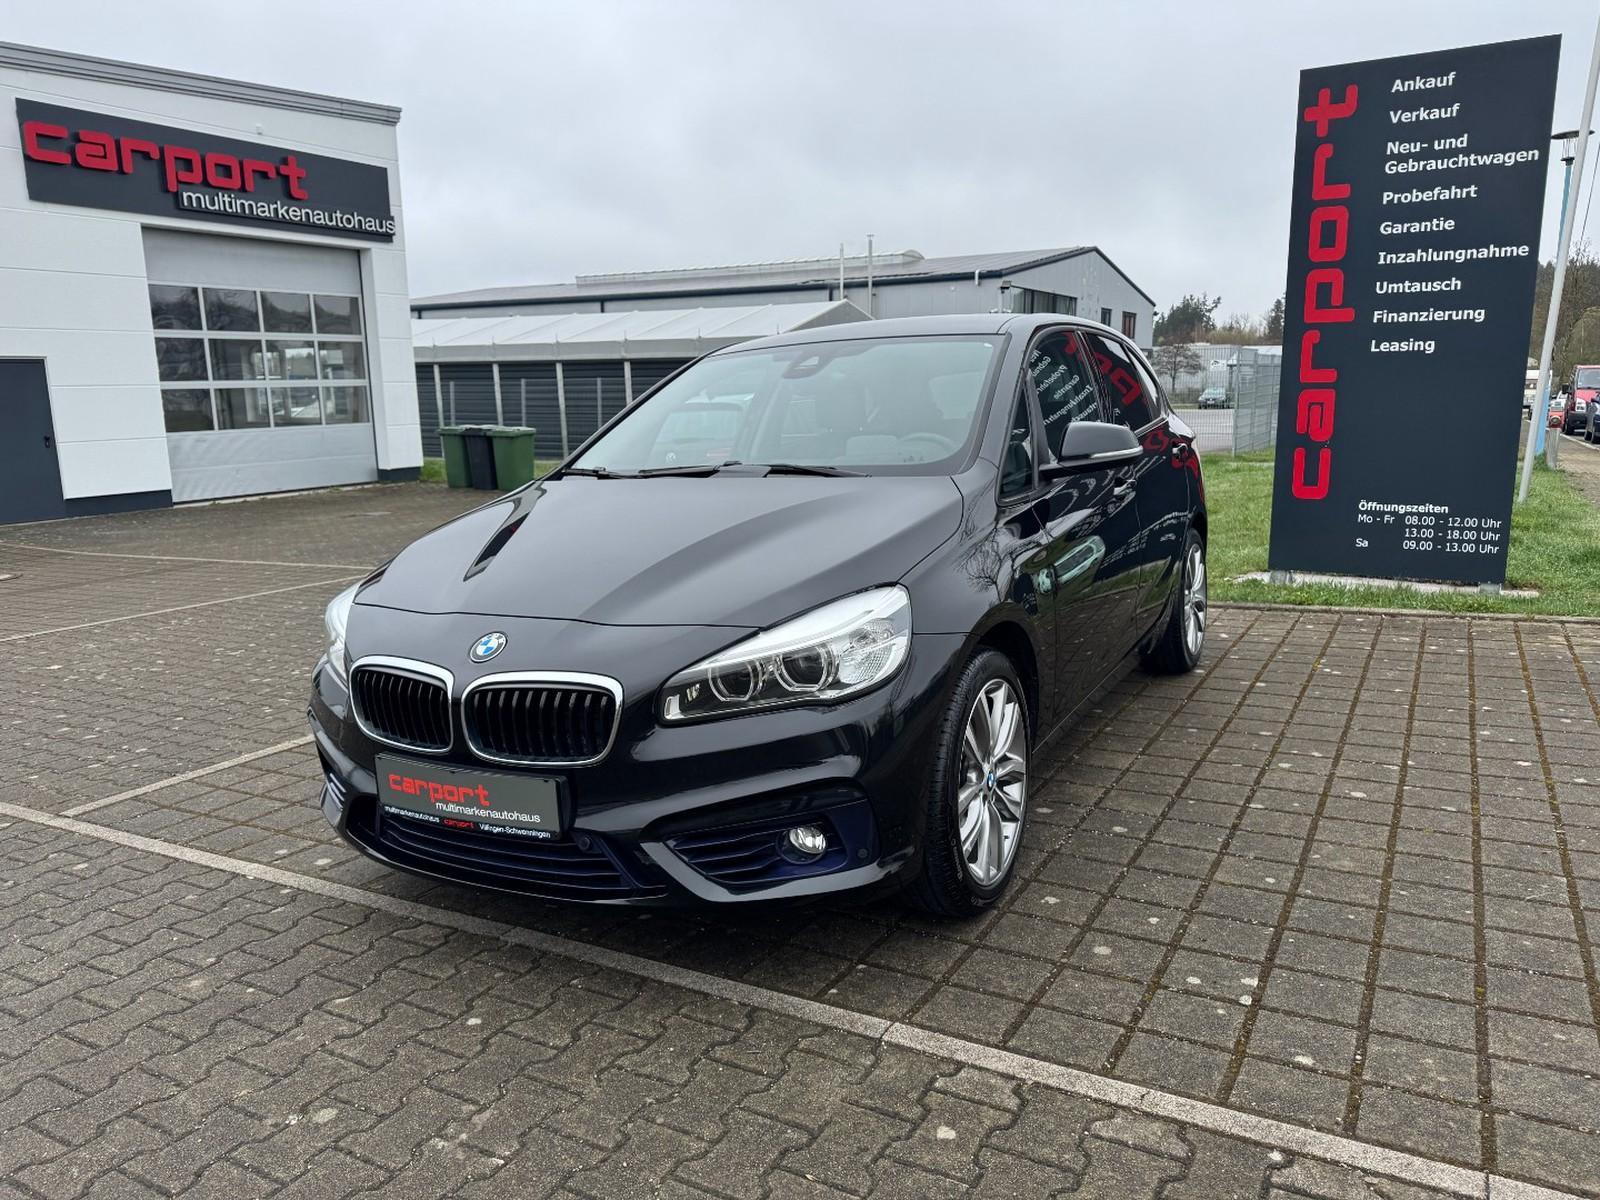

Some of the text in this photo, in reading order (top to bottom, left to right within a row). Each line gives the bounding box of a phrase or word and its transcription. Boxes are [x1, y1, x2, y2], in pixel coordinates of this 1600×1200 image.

[1391, 71, 1457, 93] Ankauf
[1389, 103, 1461, 124] Verkauf
[1386, 133, 1469, 155] Neu- und
[23, 120, 309, 200] carport
[1384, 147, 1540, 174] Gebrauchtwagen
[1382, 184, 1479, 205] Probefahrt
[182, 190, 396, 236] multimarkenautohaus
[1380, 217, 1456, 235] Garantie
[1377, 243, 1530, 265] Inzahlungnahme
[1291, 84, 1359, 500] carport
[1375, 277, 1462, 294] Umtausch
[1372, 307, 1486, 325] Finanzierung
[1370, 338, 1436, 355] Leasing
[1358, 499, 1449, 514] Öffnungszeiten
[1357, 513, 1373, 524] Mo
[1384, 514, 1396, 525] Fr
[1405, 515, 1436, 526] 08.00
[1447, 517, 1479, 528] 12.00
[1482, 518, 1502, 529] Uhr
[1355, 537, 1369, 548] Sa
[1403, 540, 1433, 551] 09.00
[1445, 542, 1476, 553] 13.00
[1479, 543, 1500, 554] Uhr
[1404, 528, 1434, 539] 13.00
[1446, 529, 1477, 541] 18.00
[1480, 531, 1501, 542] Uhr
[388, 774, 492, 807] carport
[435, 801, 541, 824] multimarkenautohaus
